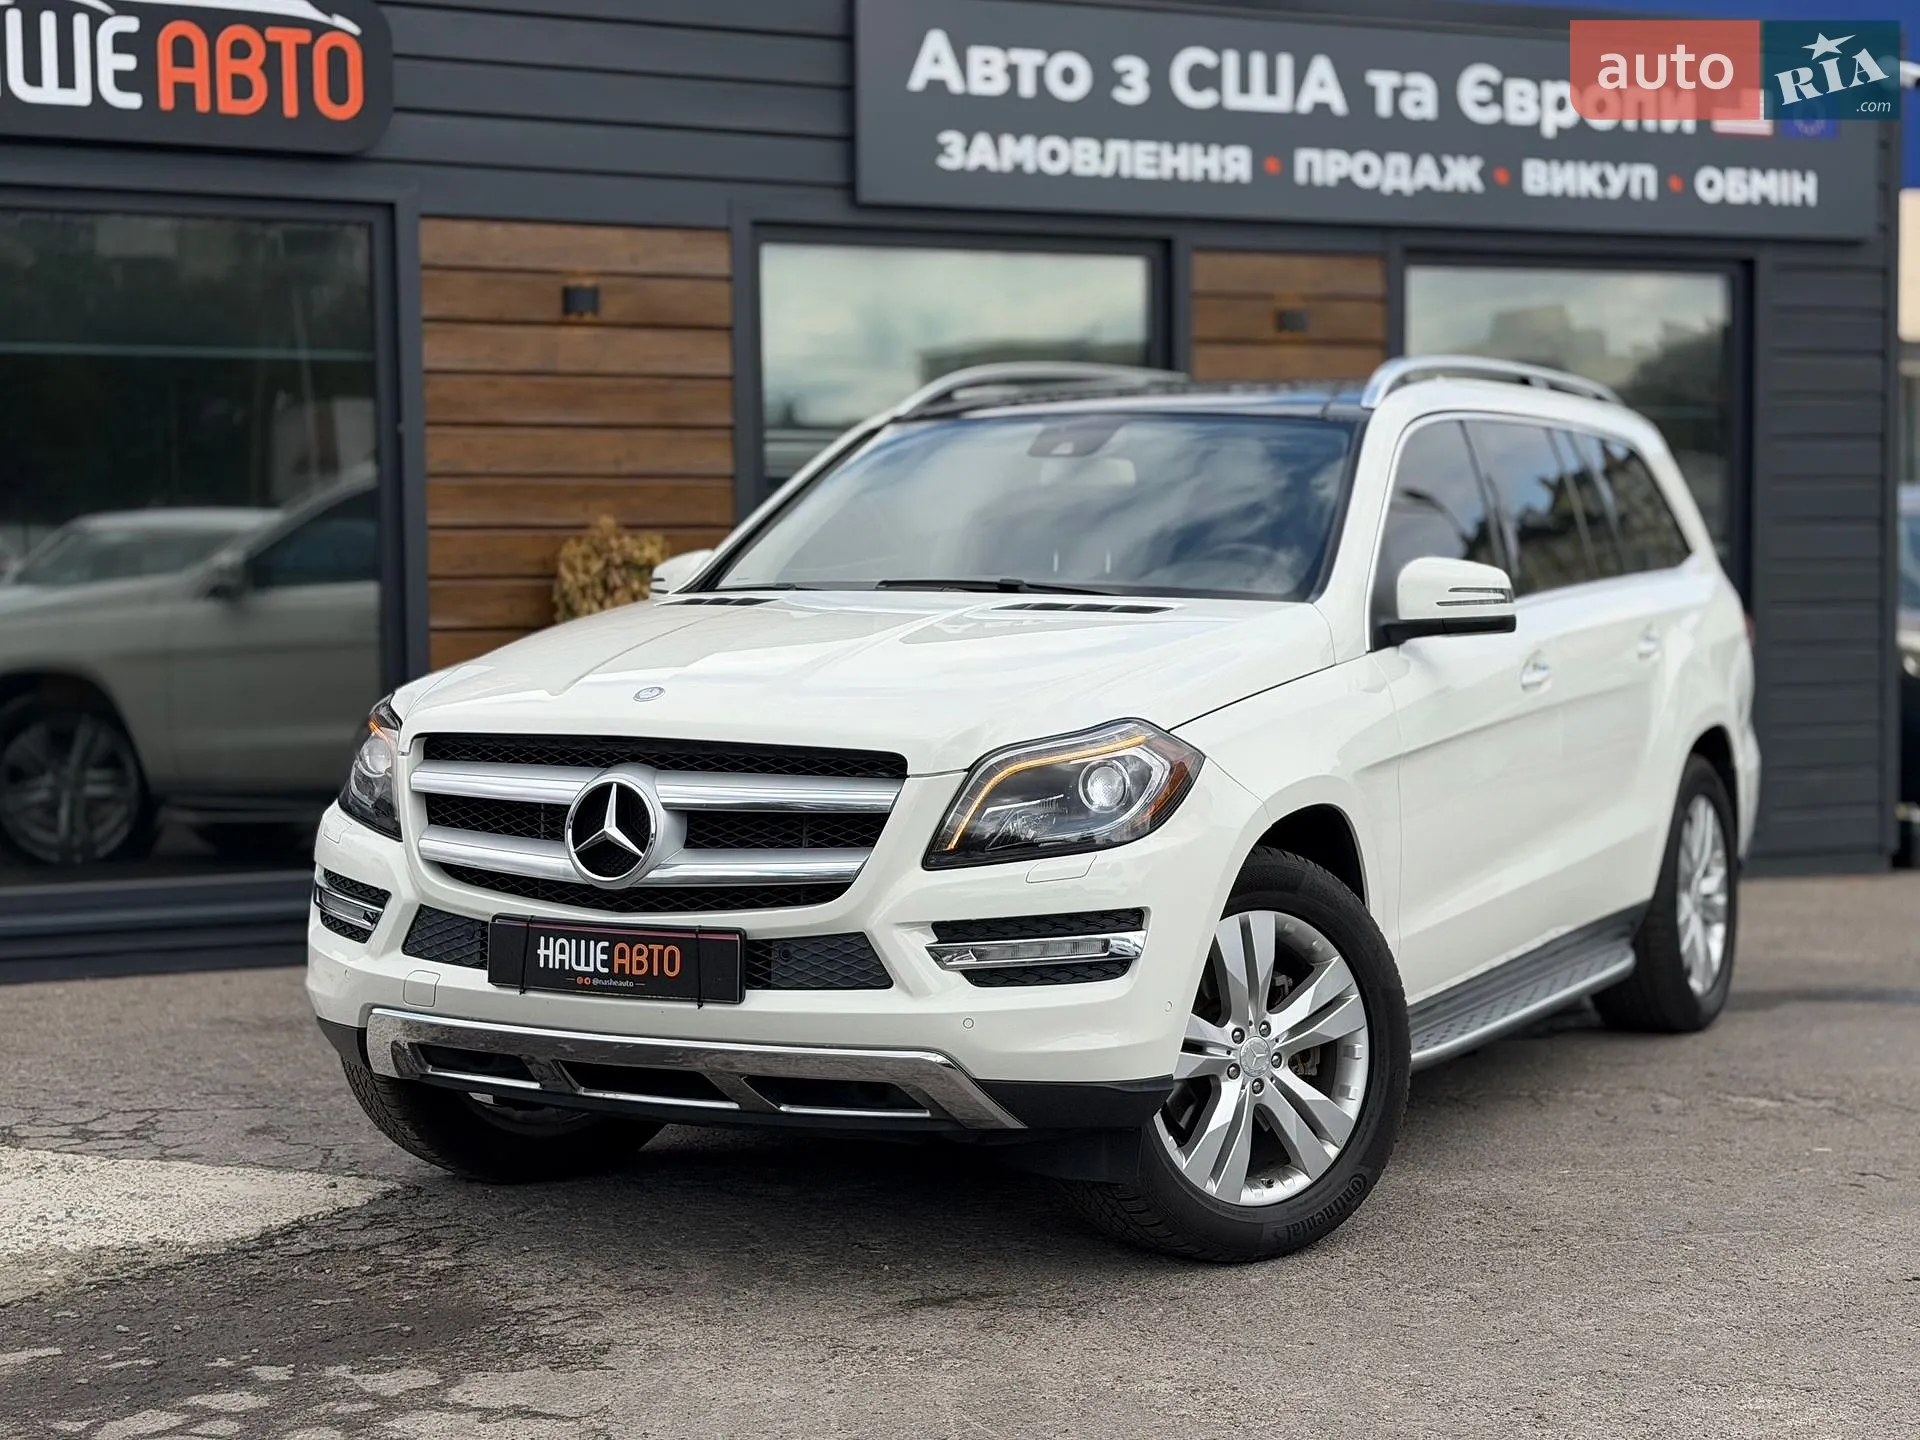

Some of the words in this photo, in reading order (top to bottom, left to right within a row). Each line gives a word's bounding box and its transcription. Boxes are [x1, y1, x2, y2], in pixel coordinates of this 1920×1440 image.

[0, 8, 143, 110] ШЕ
[157, 20, 364, 121] АВТО
[907, 29, 1094, 102] Авто
[1111, 55, 1151, 105] з
[1169, 46, 1349, 116] США
[1366, 69, 1438, 120] та
[1456, 63, 1697, 139] Європи
[936, 130, 1253, 184] ЗАМОВЛЕННЯ
[1293, 147, 1485, 197] ПРОДАЖ
[1522, 158, 1658, 202] ВИКУП
[1694, 165, 1818, 207] ОБМІН
[537, 935, 610, 973] НАШЕ
[613, 942, 681, 977] АВТО
[1286, 1172, 1368, 1241] Continental
